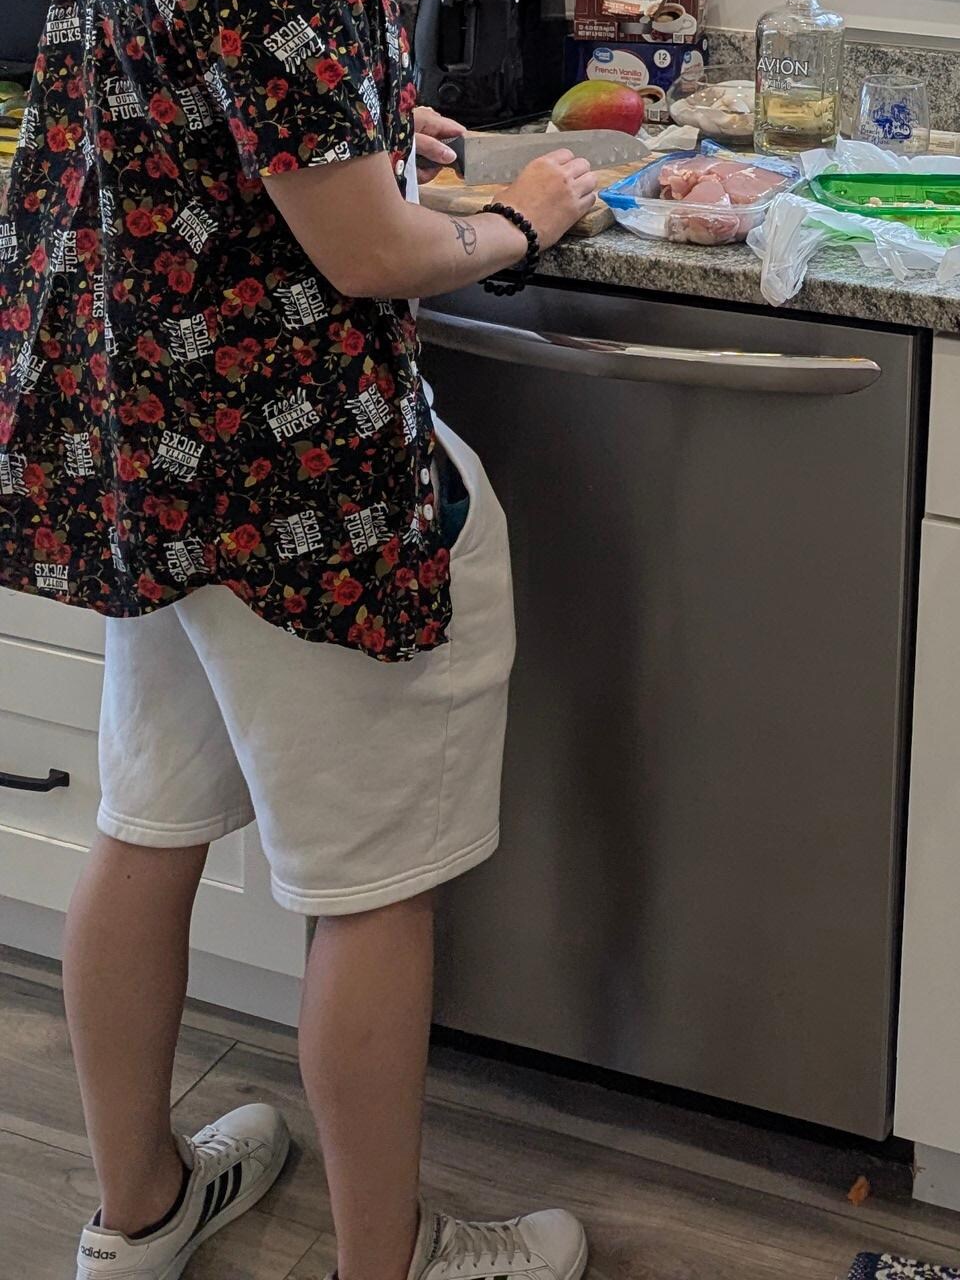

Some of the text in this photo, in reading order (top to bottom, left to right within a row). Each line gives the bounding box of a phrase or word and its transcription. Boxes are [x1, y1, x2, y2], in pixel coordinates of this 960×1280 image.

[47, 2, 79, 20] Fresh
[50, 20, 74, 30] OUTTA
[46, 28, 81, 45] FUCKS
[264, 15, 309, 53] FUCKS
[281, 31, 311, 54] OUTTA
[282, 34, 326, 74] Fresh
[595, 66, 642, 77] French Vanilla
[658, 52, 667, 61] 12
[175, 88, 203, 130] FUCKS
[186, 198, 219, 234] Fresh
[65, 230, 77, 273] FUCKS
[171, 217, 203, 254] FUCKS
[92, 274, 104, 318] FUCKS
[273, 288, 300, 330] Fresh
[295, 291, 311, 319] OUTTA
[302, 277, 328, 321] FUCKS
[163, 318, 189, 363] Fresh
[182, 326, 196, 353] OUTTA
[192, 313, 213, 357] FUCKS
[262, 387, 306, 418] Fresh
[276, 407, 304, 425] OUTTA
[344, 398, 377, 439] Fresh
[363, 398, 381, 428] OUTTA
[369, 383, 394, 424] FUCKS
[161, 430, 205, 458] FUCKS
[273, 410, 320, 442] FUCKS
[81, 431, 95, 476] FUCKS
[165, 447, 192, 464] OUTTA
[13, 452, 30, 496] Fresh
[270, 519, 294, 560] Fresh
[290, 519, 306, 549] OUTTA
[301, 509, 324, 551] FUCKS
[344, 513, 368, 556] FUCKS
[35, 563, 69, 579] FUCKS
[163, 542, 187, 583] FUCKS
[80, 1245, 117, 1260] adidas
